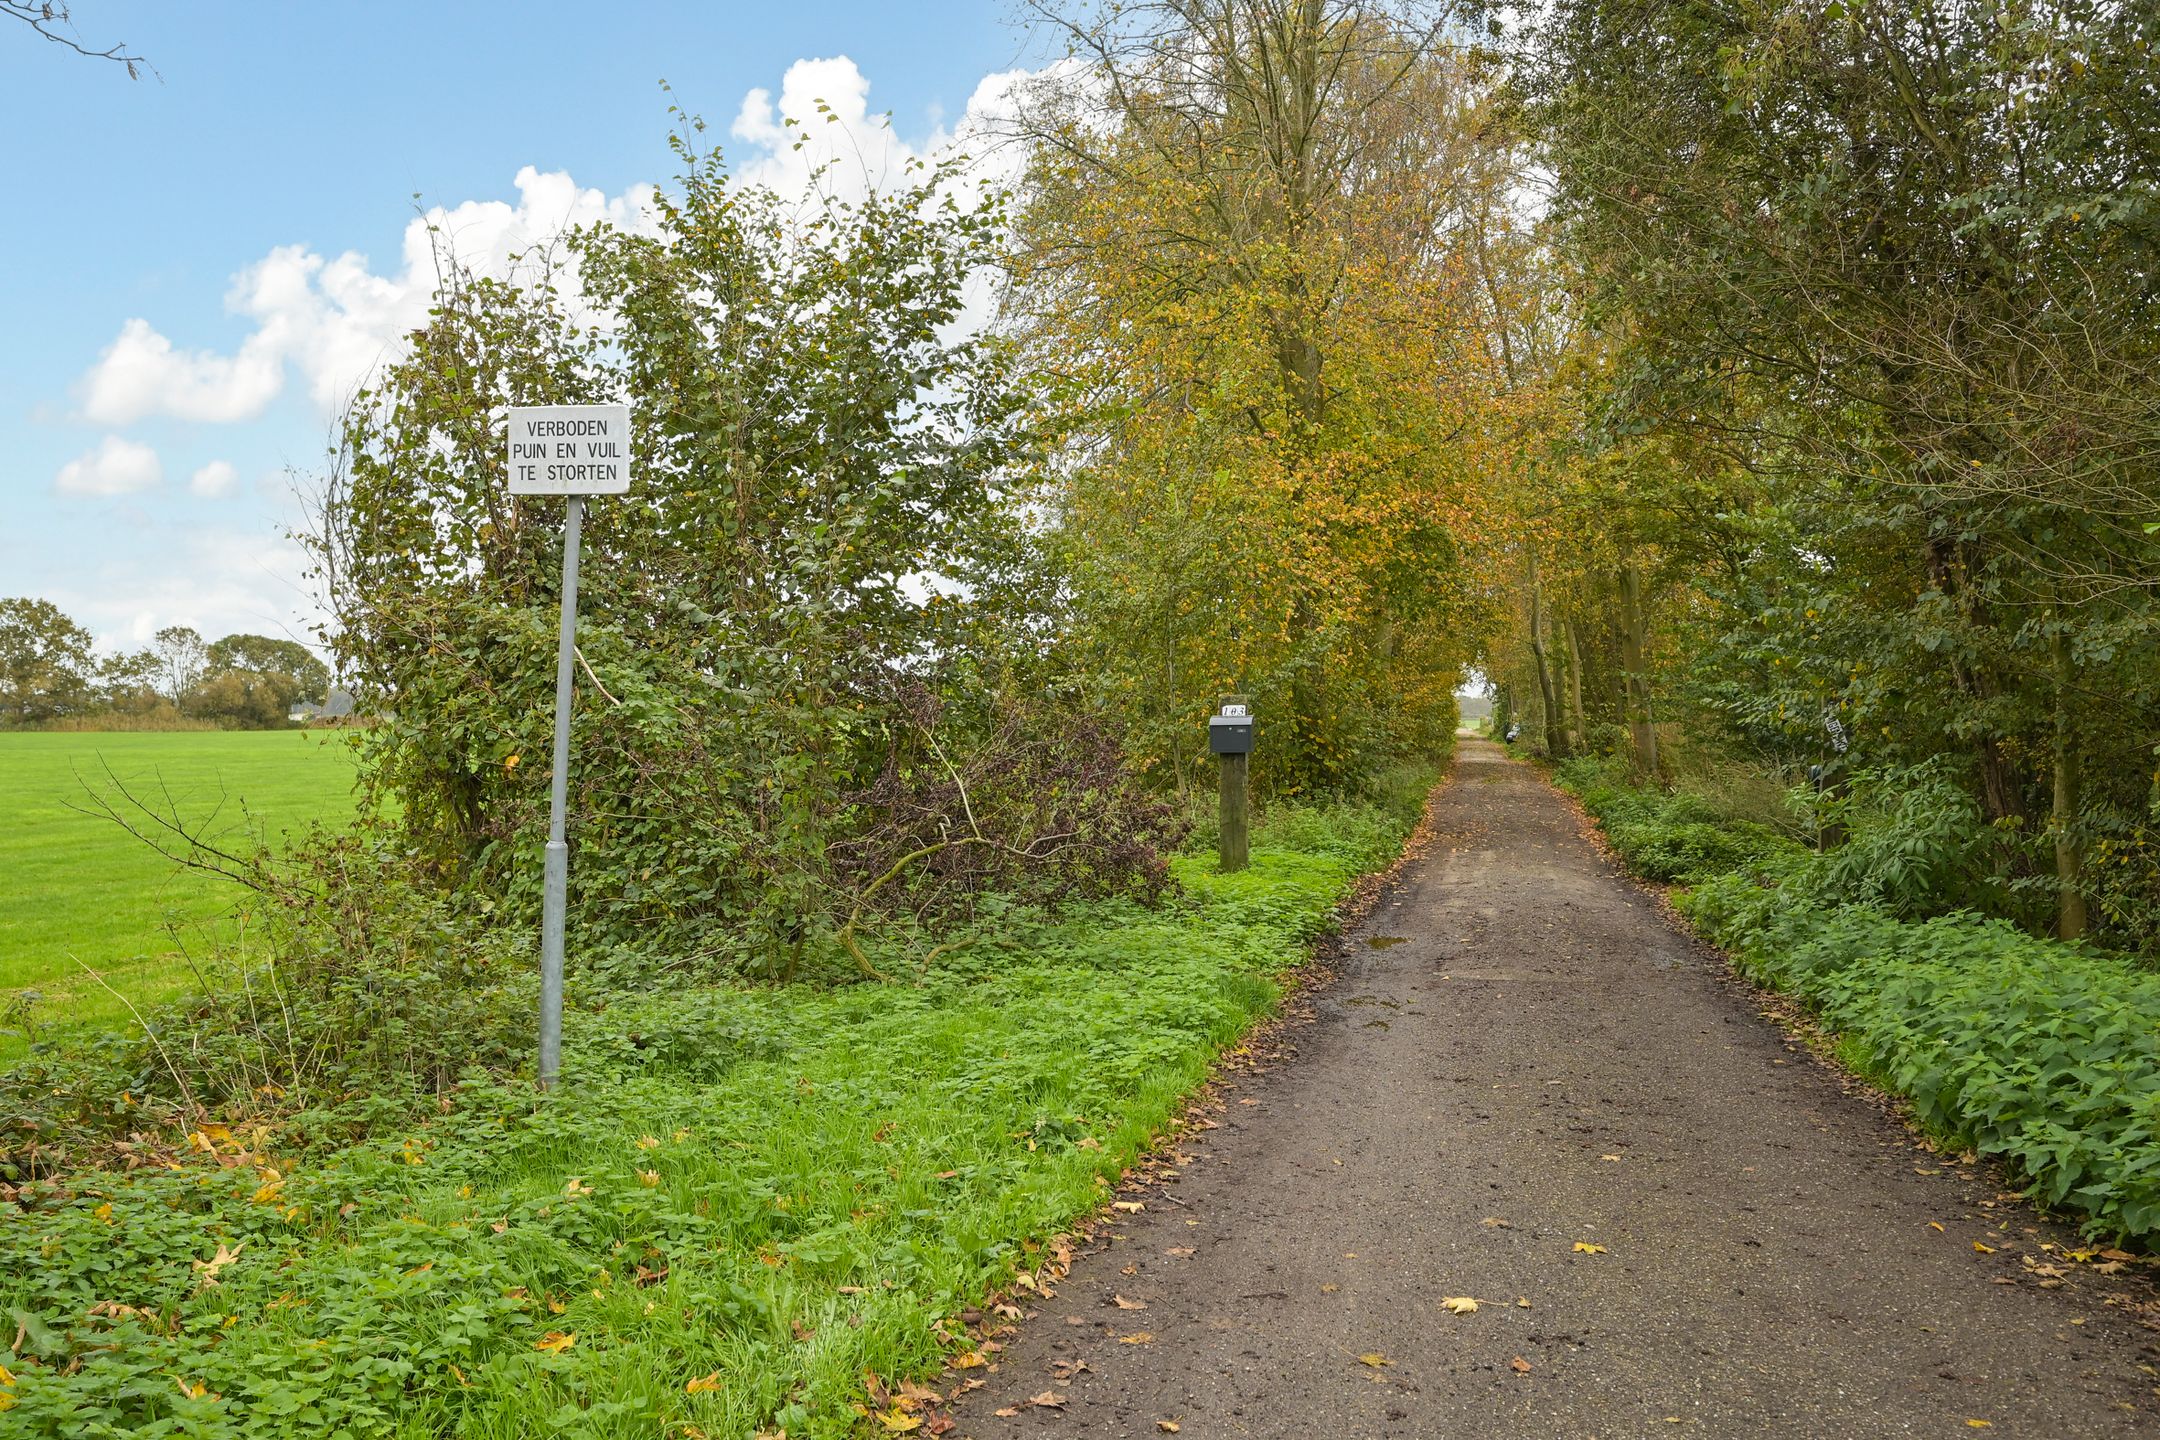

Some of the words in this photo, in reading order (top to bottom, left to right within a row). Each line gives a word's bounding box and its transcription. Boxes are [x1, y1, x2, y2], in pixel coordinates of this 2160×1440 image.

[527, 420, 608, 437] VERBODEN
[513, 443, 546, 459] PUIN
[556, 443, 577, 458] EN
[587, 442, 621, 458] VUIL
[517, 465, 536, 481] TE
[547, 464, 617, 480] STORTEN
